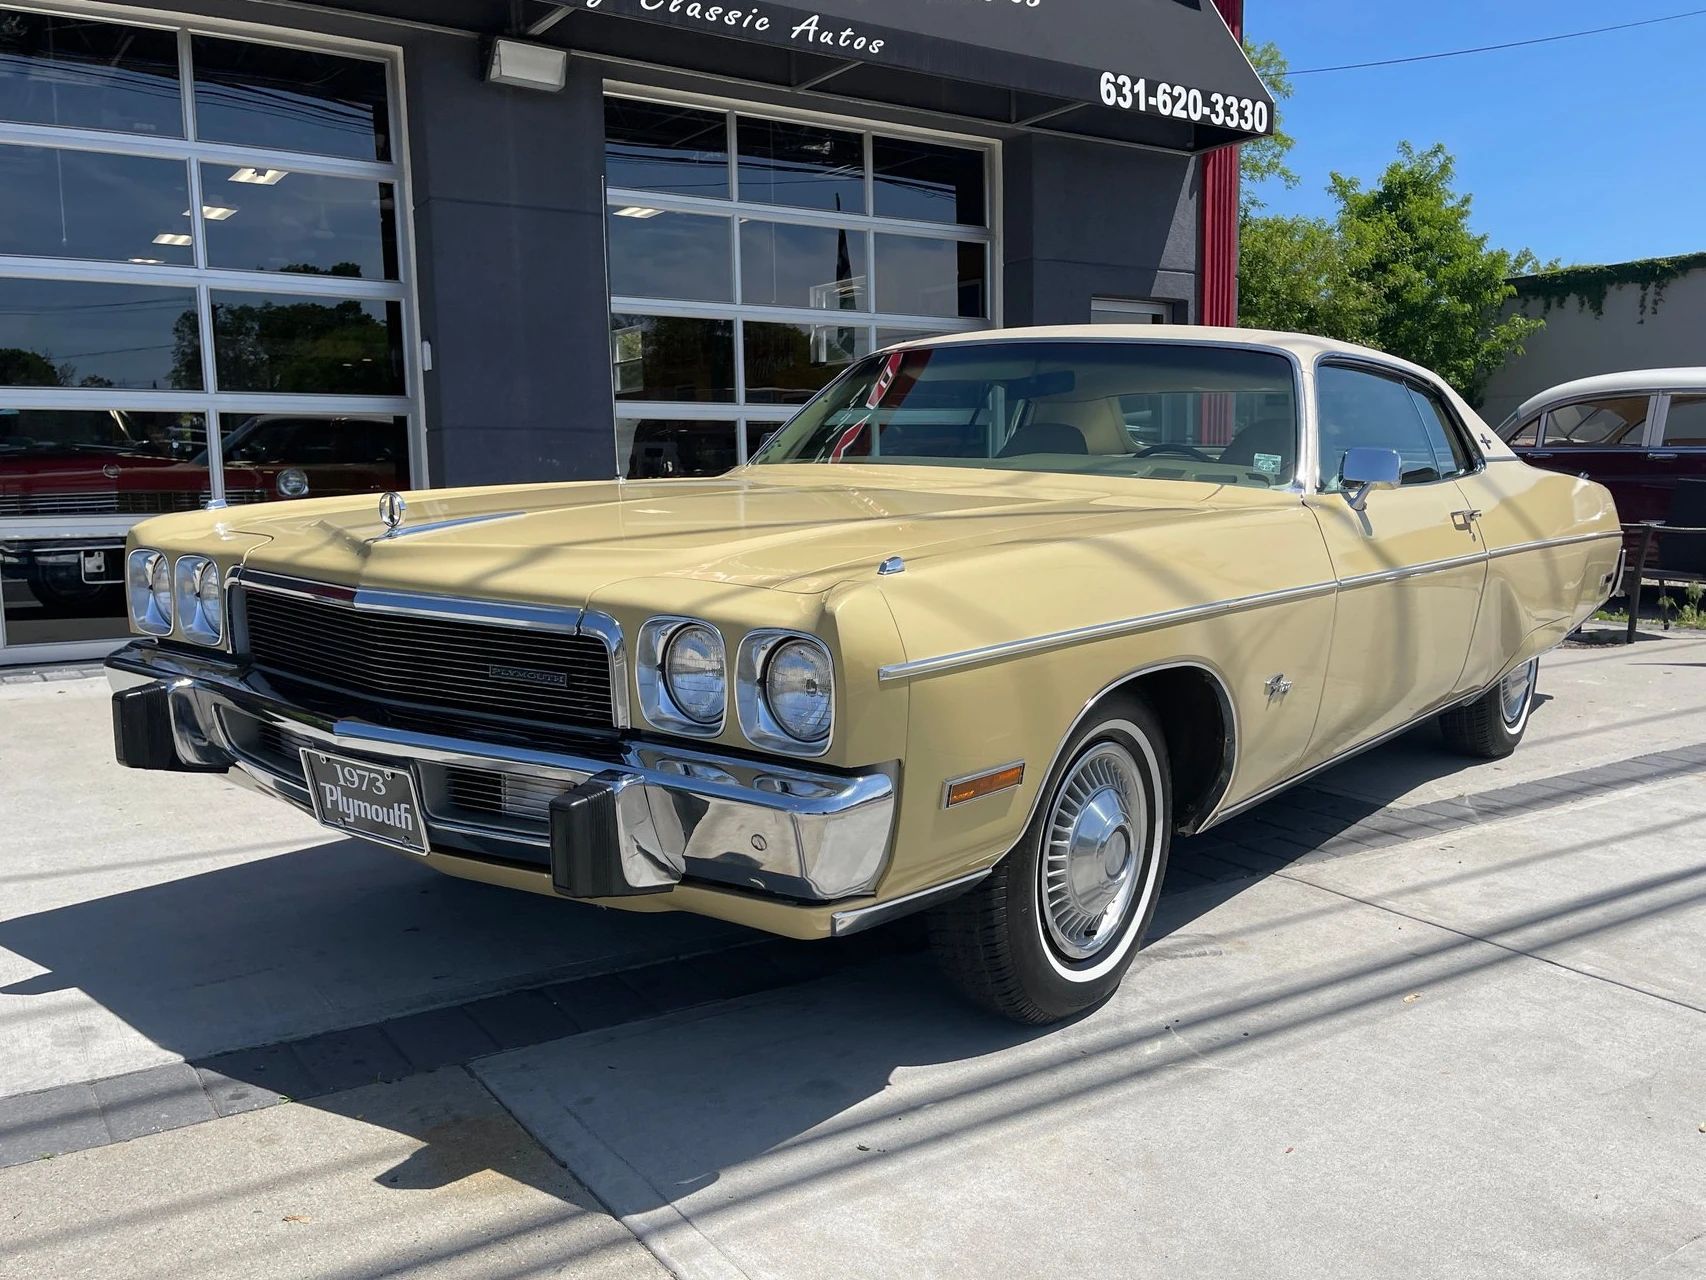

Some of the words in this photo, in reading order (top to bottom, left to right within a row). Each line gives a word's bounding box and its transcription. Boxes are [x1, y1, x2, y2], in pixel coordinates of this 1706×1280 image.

[790, 14, 885, 54] Autos
[1100, 71, 1268, 133] 631-620-3330
[490, 666, 565, 683] PLYMOUTH
[333, 763, 386, 795] 1973
[320, 782, 412, 831] Plymouth
